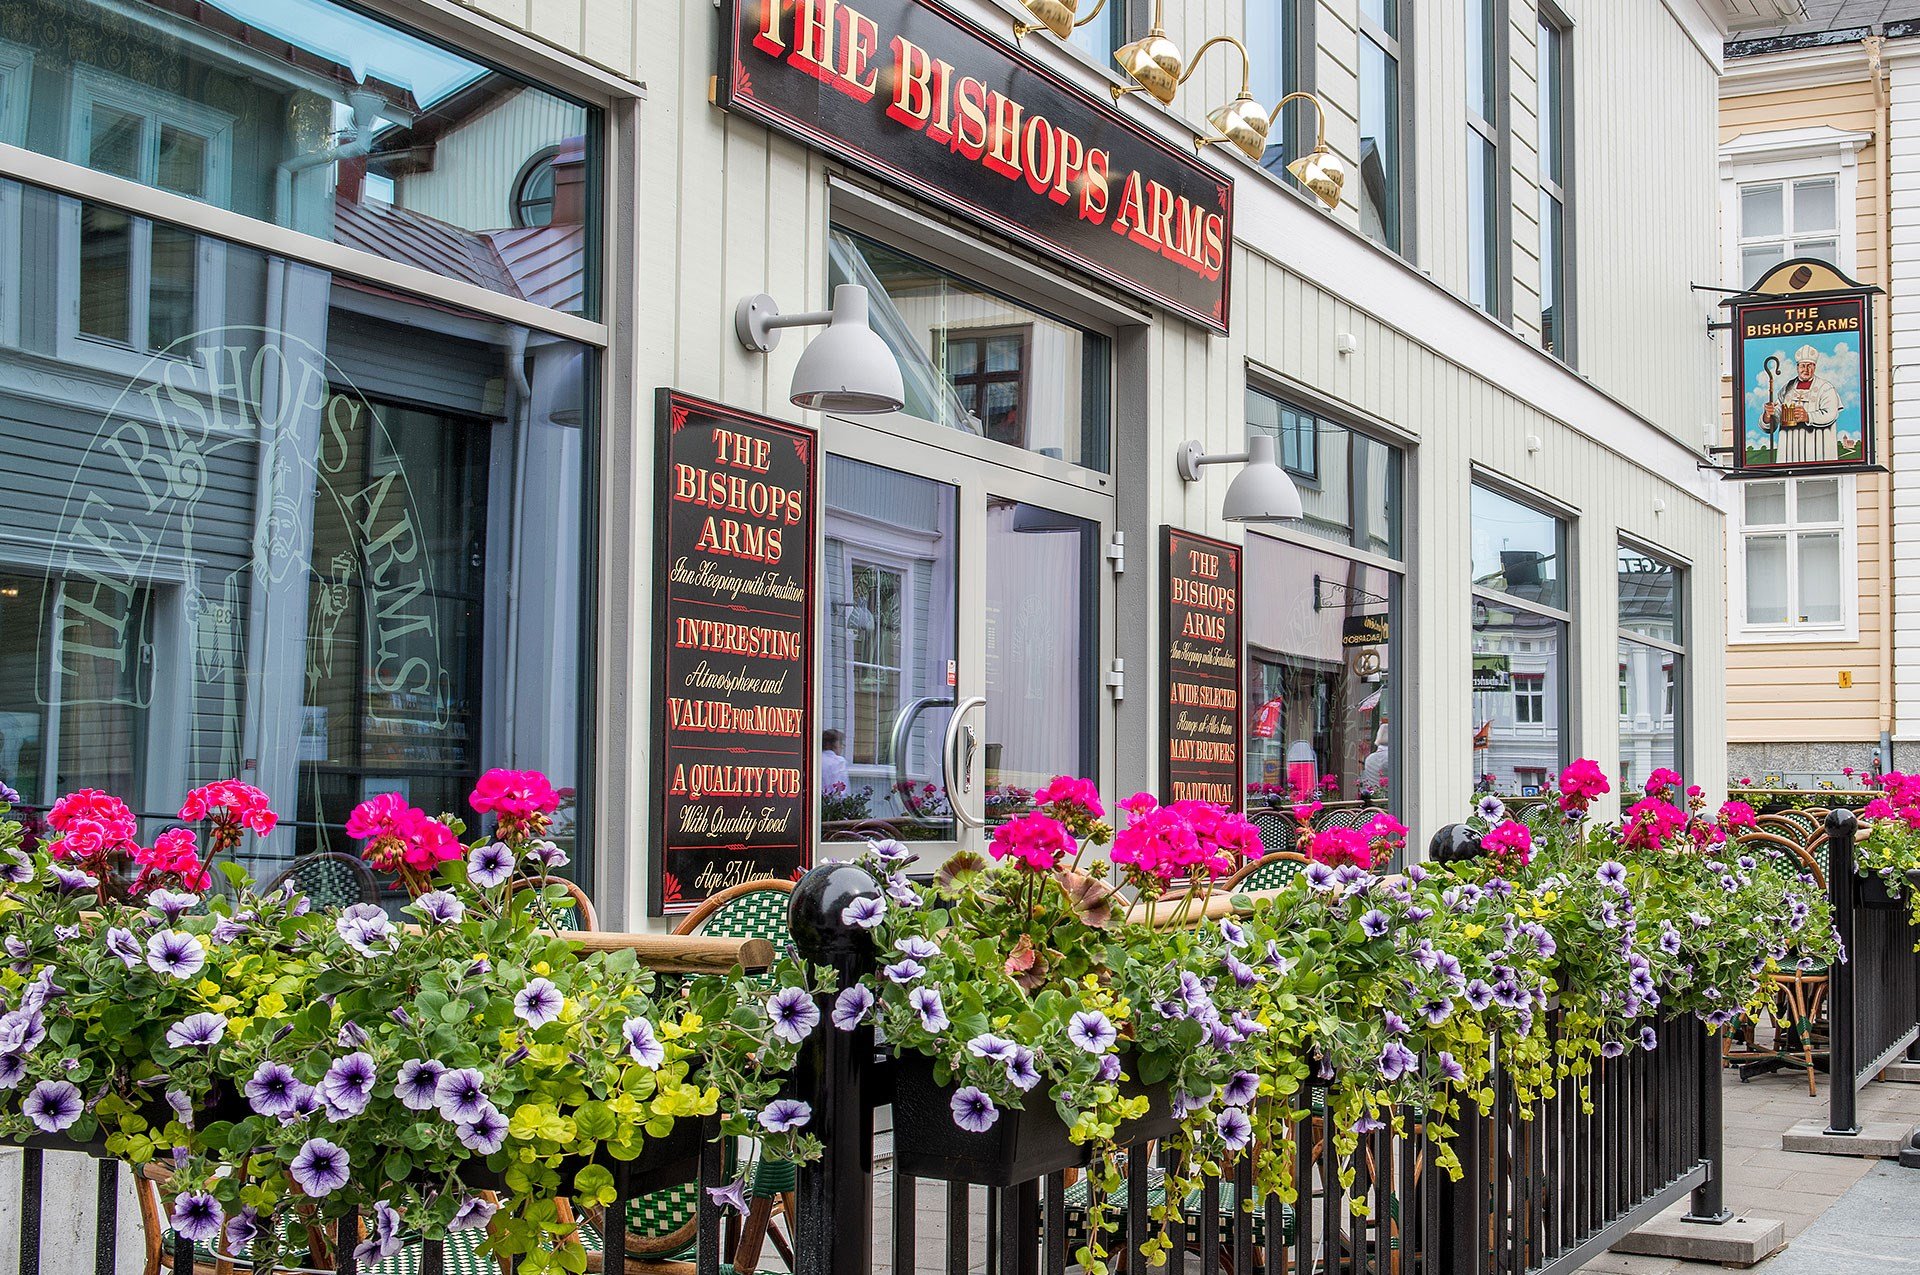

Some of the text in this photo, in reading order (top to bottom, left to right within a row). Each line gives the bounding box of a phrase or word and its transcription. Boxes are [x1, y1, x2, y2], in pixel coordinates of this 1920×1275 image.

[886, 36, 1110, 225] BISHOPS
[1112, 170, 1225, 281] ARMS
[1747, 317, 1859, 337] BISHOPS ARMS
[1785, 307, 1819, 320] THE
[712, 428, 771, 474] THE
[674, 462, 802, 526] BISHOPS
[54, 343, 432, 696] THE BISHOPS ARMS
[694, 516, 782, 565] ARMS
[670, 556, 804, 603] Inn Keeping with Tradition
[1189, 549, 1219, 580] THE
[1172, 577, 1236, 615] BISHOPS
[675, 617, 800, 662] INTERESTING
[1181, 612, 1226, 644] ARMS
[685, 660, 788, 697] Atmosphere and
[1170, 682, 1178, 704] A
[1177, 683, 1199, 707] WIDE
[1199, 685, 1237, 711] SELECTED
[667, 697, 803, 737] VALUE FOR MONEY
[1170, 739, 1235, 764] MANY BREWERS
[669, 763, 801, 800] A QUALITY PUB
[1173, 781, 1234, 805] TRADITIONAL
[679, 805, 791, 840] With Quality Food
[694, 861, 723, 897] Age
[722, 860, 743, 888] 23
